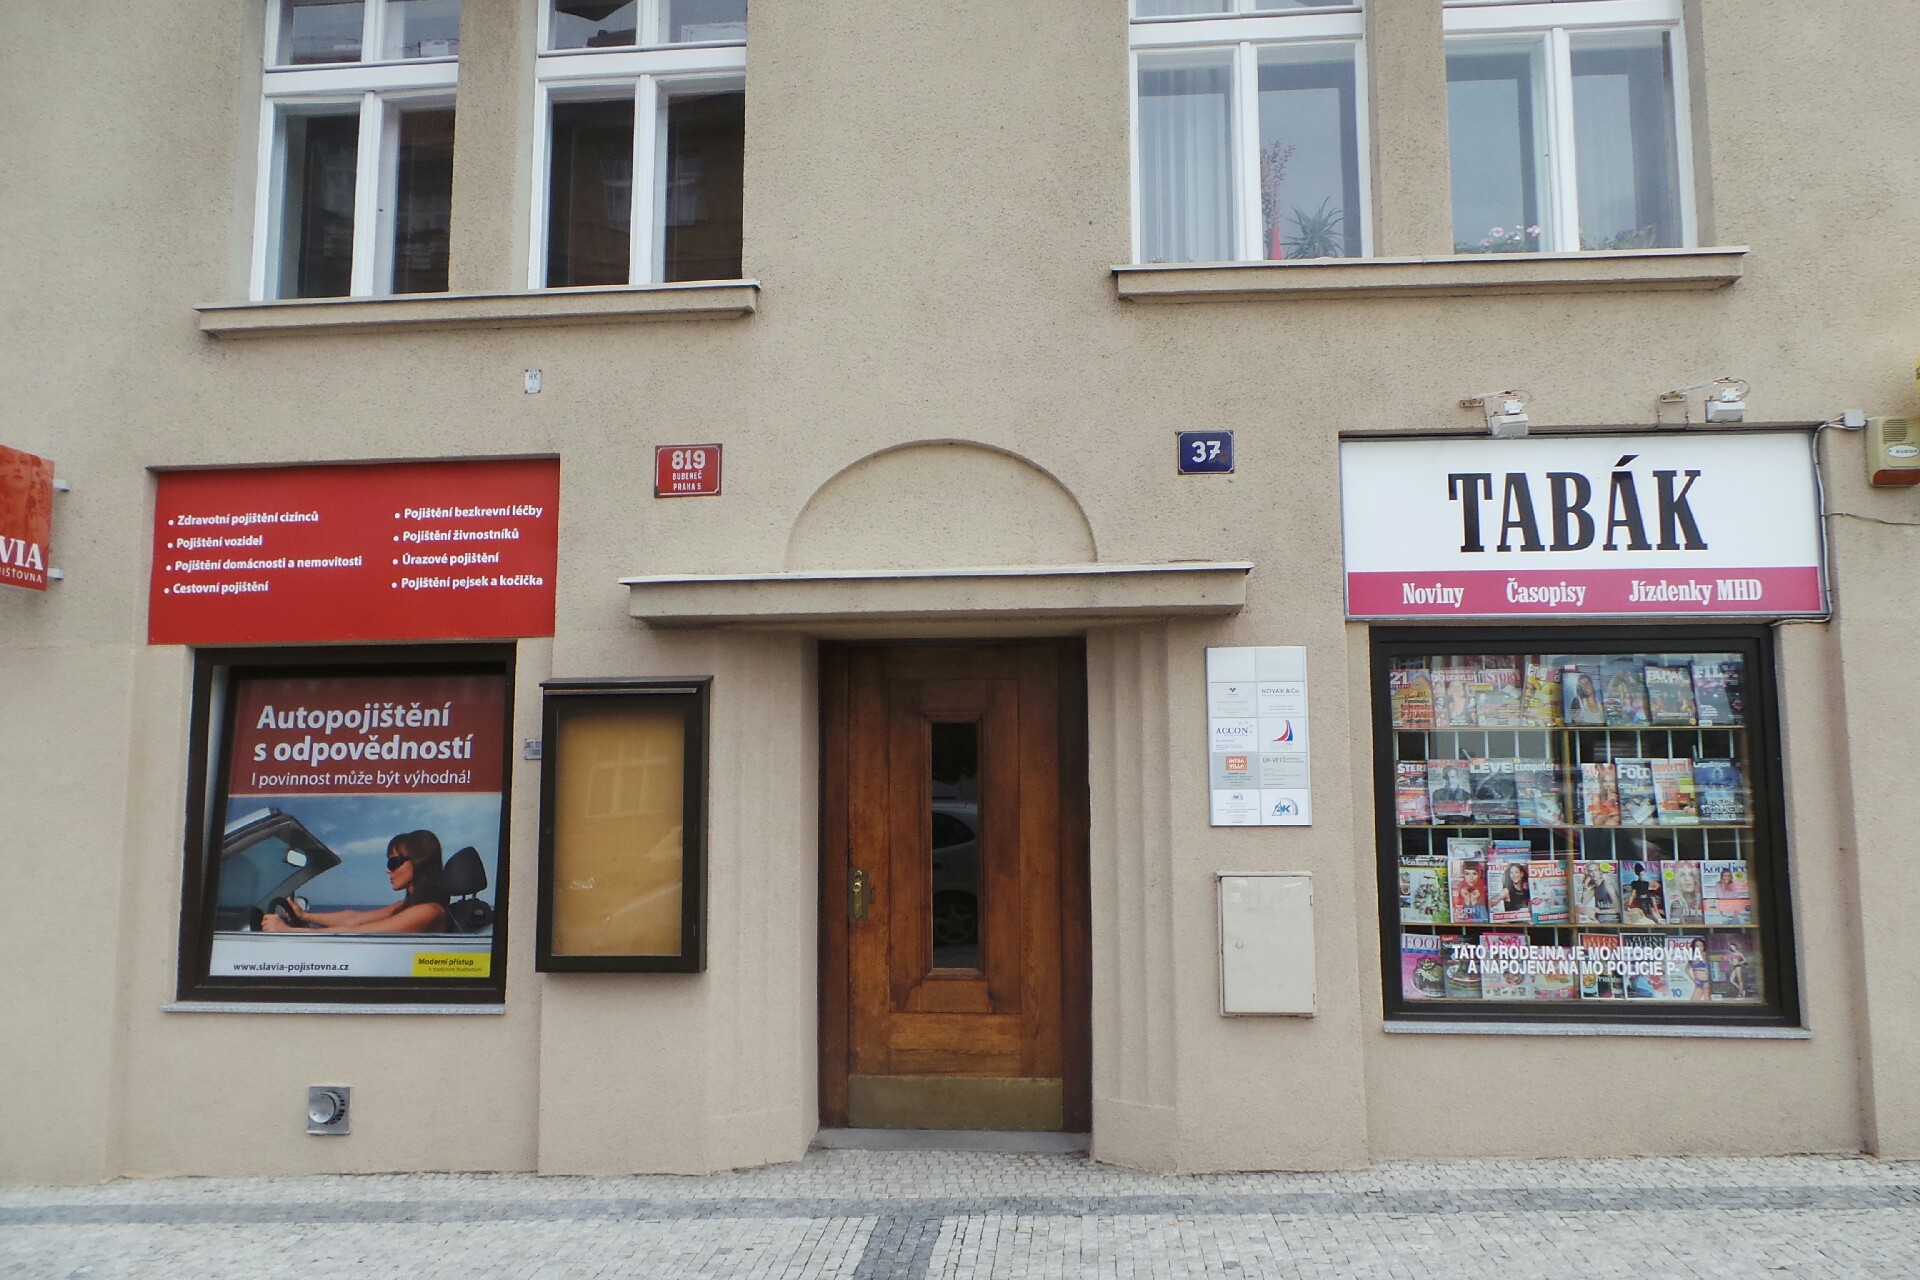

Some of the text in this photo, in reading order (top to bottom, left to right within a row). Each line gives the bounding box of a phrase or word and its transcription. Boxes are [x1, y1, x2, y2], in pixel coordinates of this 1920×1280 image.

[671, 449, 706, 470] 819
[1191, 440, 1222, 463] 37
[1447, 454, 1708, 553] TABÁK
[177, 510, 319, 526] Zdravotní pojištění cizinců
[404, 504, 543, 521] Pojištění bezkrevní léčby
[176, 534, 263, 551] Pojištění vozidel
[402, 528, 519, 544] Pojištění živnostníků
[174, 554, 363, 574] Pojištění domácnosti a nemovitosti
[402, 552, 500, 567] Úrazové pojištění
[172, 580, 269, 595] Cestovní pojištění
[401, 574, 544, 591] Pojištění pejsek a kočička
[1402, 577, 1763, 608] Noviny Časopisy Jízdenky MHD
[1390, 671, 1409, 685] 21
[256, 702, 452, 734] Autopojištění
[1215, 727, 1249, 735] ACCON
[253, 733, 474, 767] s odpovědností
[251, 768, 471, 788] I povinnost může být výhodná!
[1453, 944, 1486, 960] TATO
[1489, 945, 1565, 960] PRODEJNA
[1567, 945, 1586, 960] JE
[1588, 946, 1703, 961] MONITOROVANA
[233, 962, 349, 973] www.slavia-pojistovna.cz
[1467, 960, 1478, 974] A
[1480, 960, 1555, 975] NAPOJENA
[1559, 961, 1579, 975] NA
[1581, 961, 1604, 976] MO
[1607, 961, 1664, 976] POLICIE
